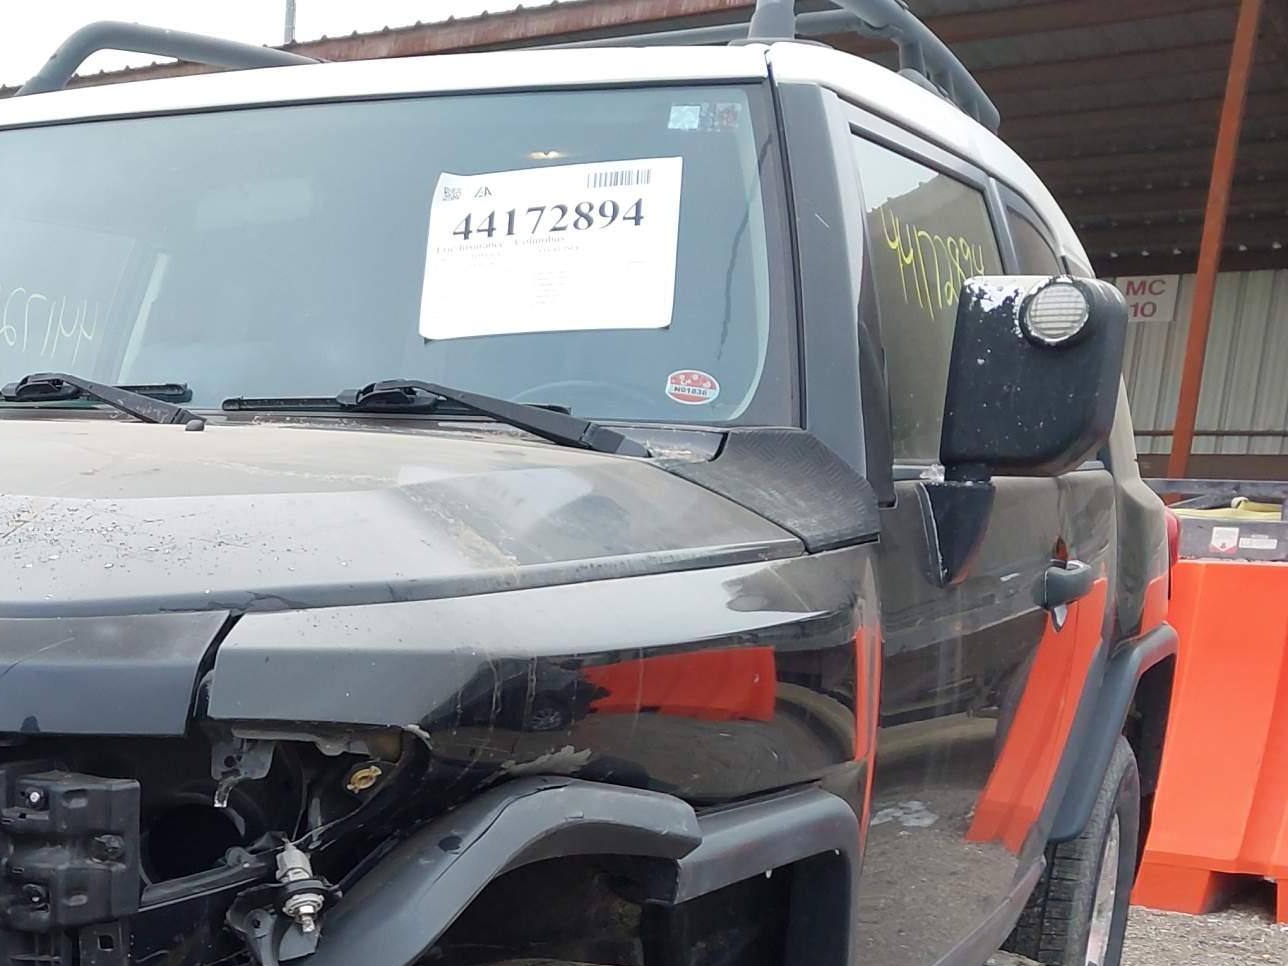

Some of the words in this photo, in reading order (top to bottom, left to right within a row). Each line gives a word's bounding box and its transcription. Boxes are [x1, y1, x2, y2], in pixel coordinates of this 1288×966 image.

[452, 197, 645, 241] 44172894
[1125, 279, 1167, 296] MC
[1129, 301, 1158, 318] 10
